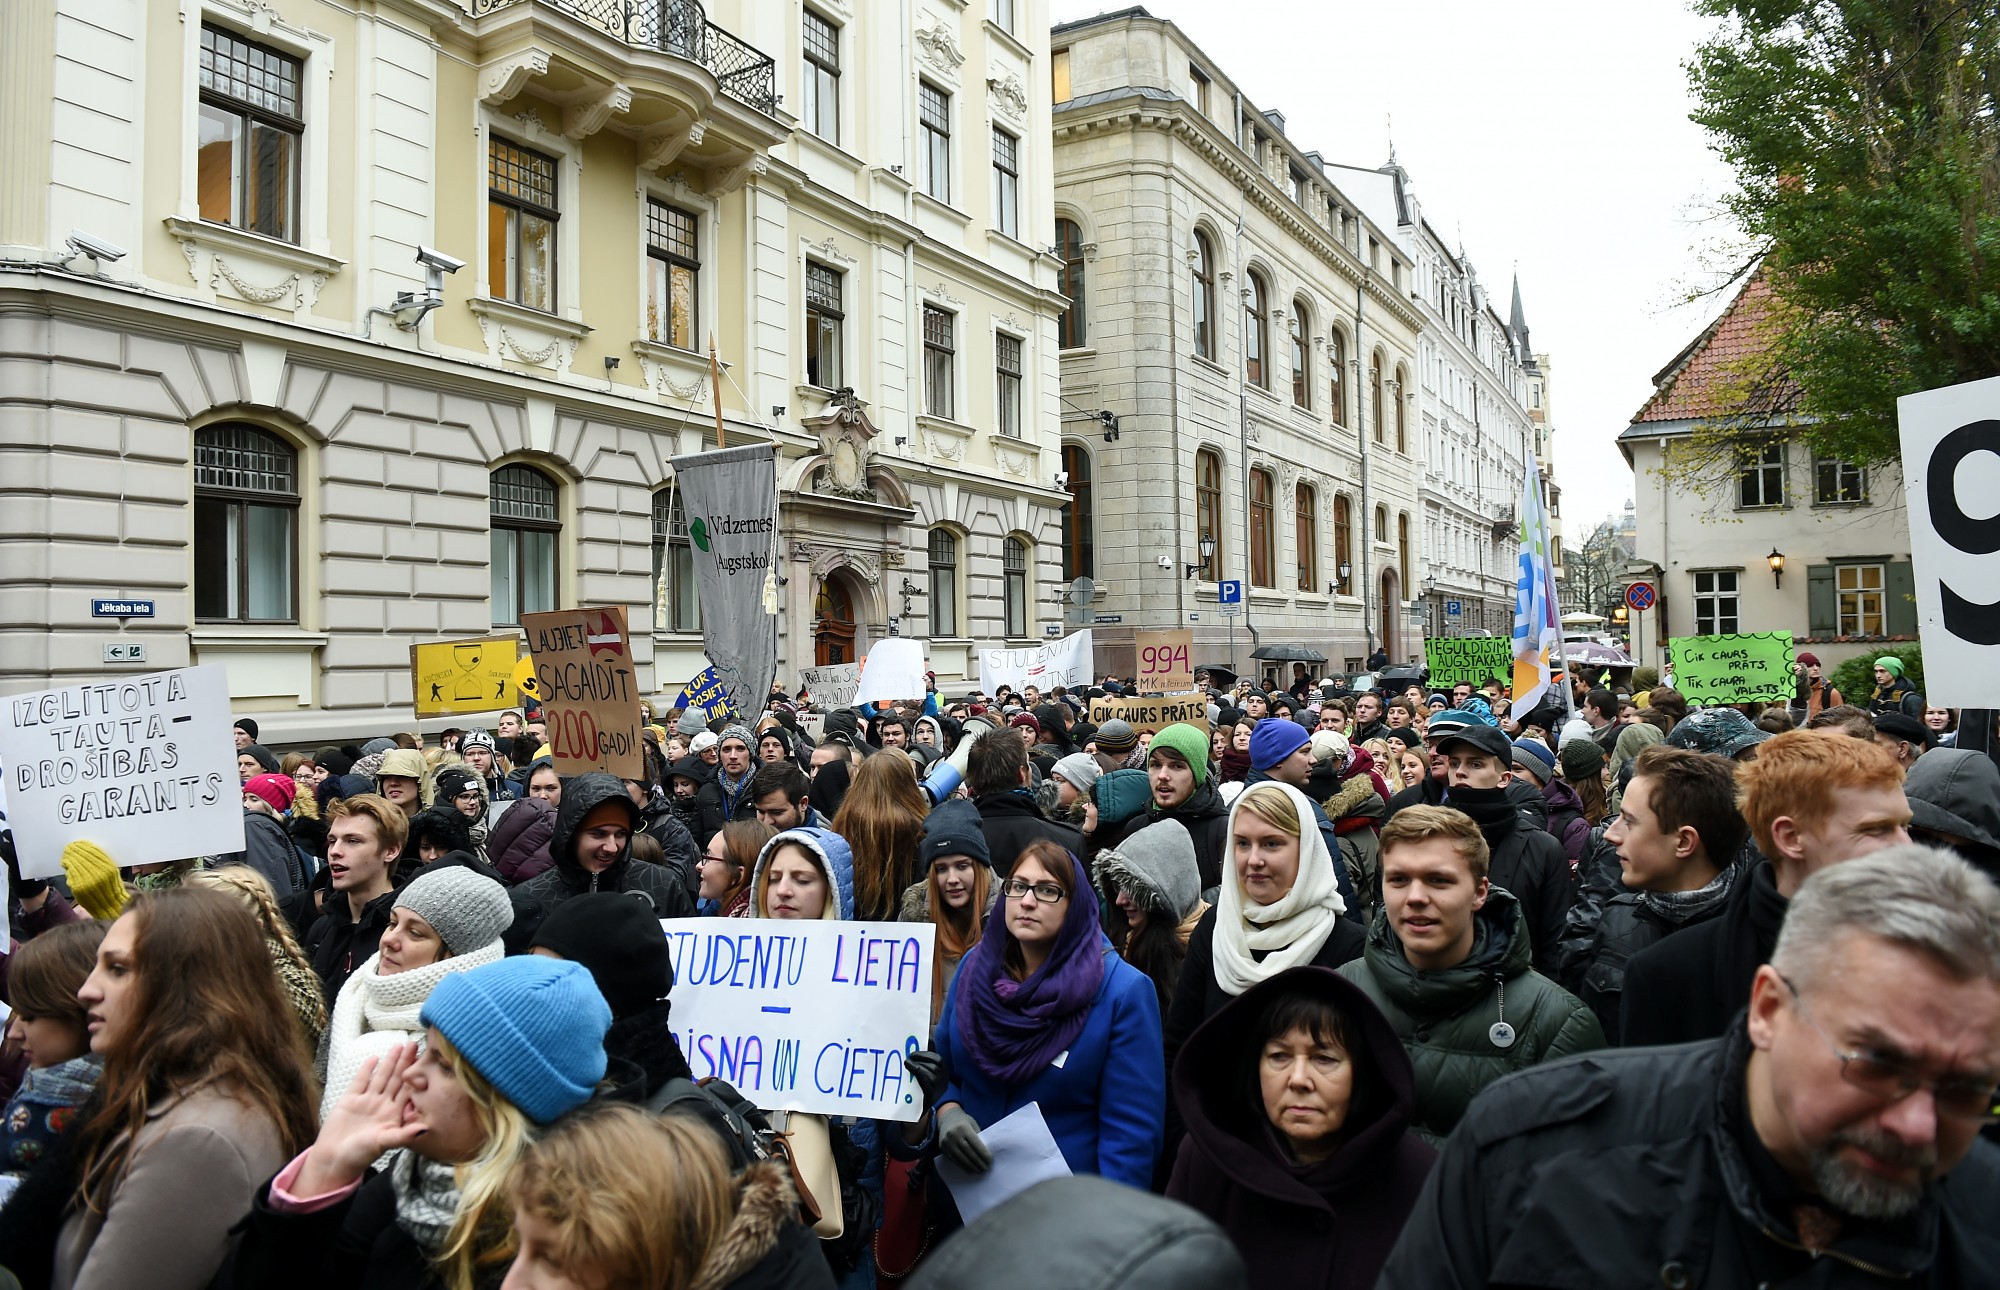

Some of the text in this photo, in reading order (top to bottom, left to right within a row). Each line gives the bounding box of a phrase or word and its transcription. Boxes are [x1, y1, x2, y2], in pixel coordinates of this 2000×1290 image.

[709, 514, 773, 536] Vidzemes
[718, 550, 769, 576] Augstskol
[1223, 583, 1236, 601] P
[99, 603, 149, 613] Jēkaba iela
[989, 637, 1071, 669] STUDENTI
[1712, 649, 1748, 661] CAURS
[1728, 660, 1767, 672] PRĀTS,
[539, 658, 630, 702] SAGAIDĪT
[683, 672, 710, 699] KUR
[1139, 677, 1158, 690] MK
[1710, 676, 1745, 687] CAURA
[13, 673, 187, 728] IZGLĪTOTA
[1093, 701, 1208, 724] CIK CAURS PRĀTS,
[547, 708, 637, 762] 200 GADI!
[17, 742, 179, 792] DROŠĪBAS
[58, 772, 223, 824] GARANTS
[664, 931, 807, 989] TUDENTU
[772, 1038, 801, 1092] UN
